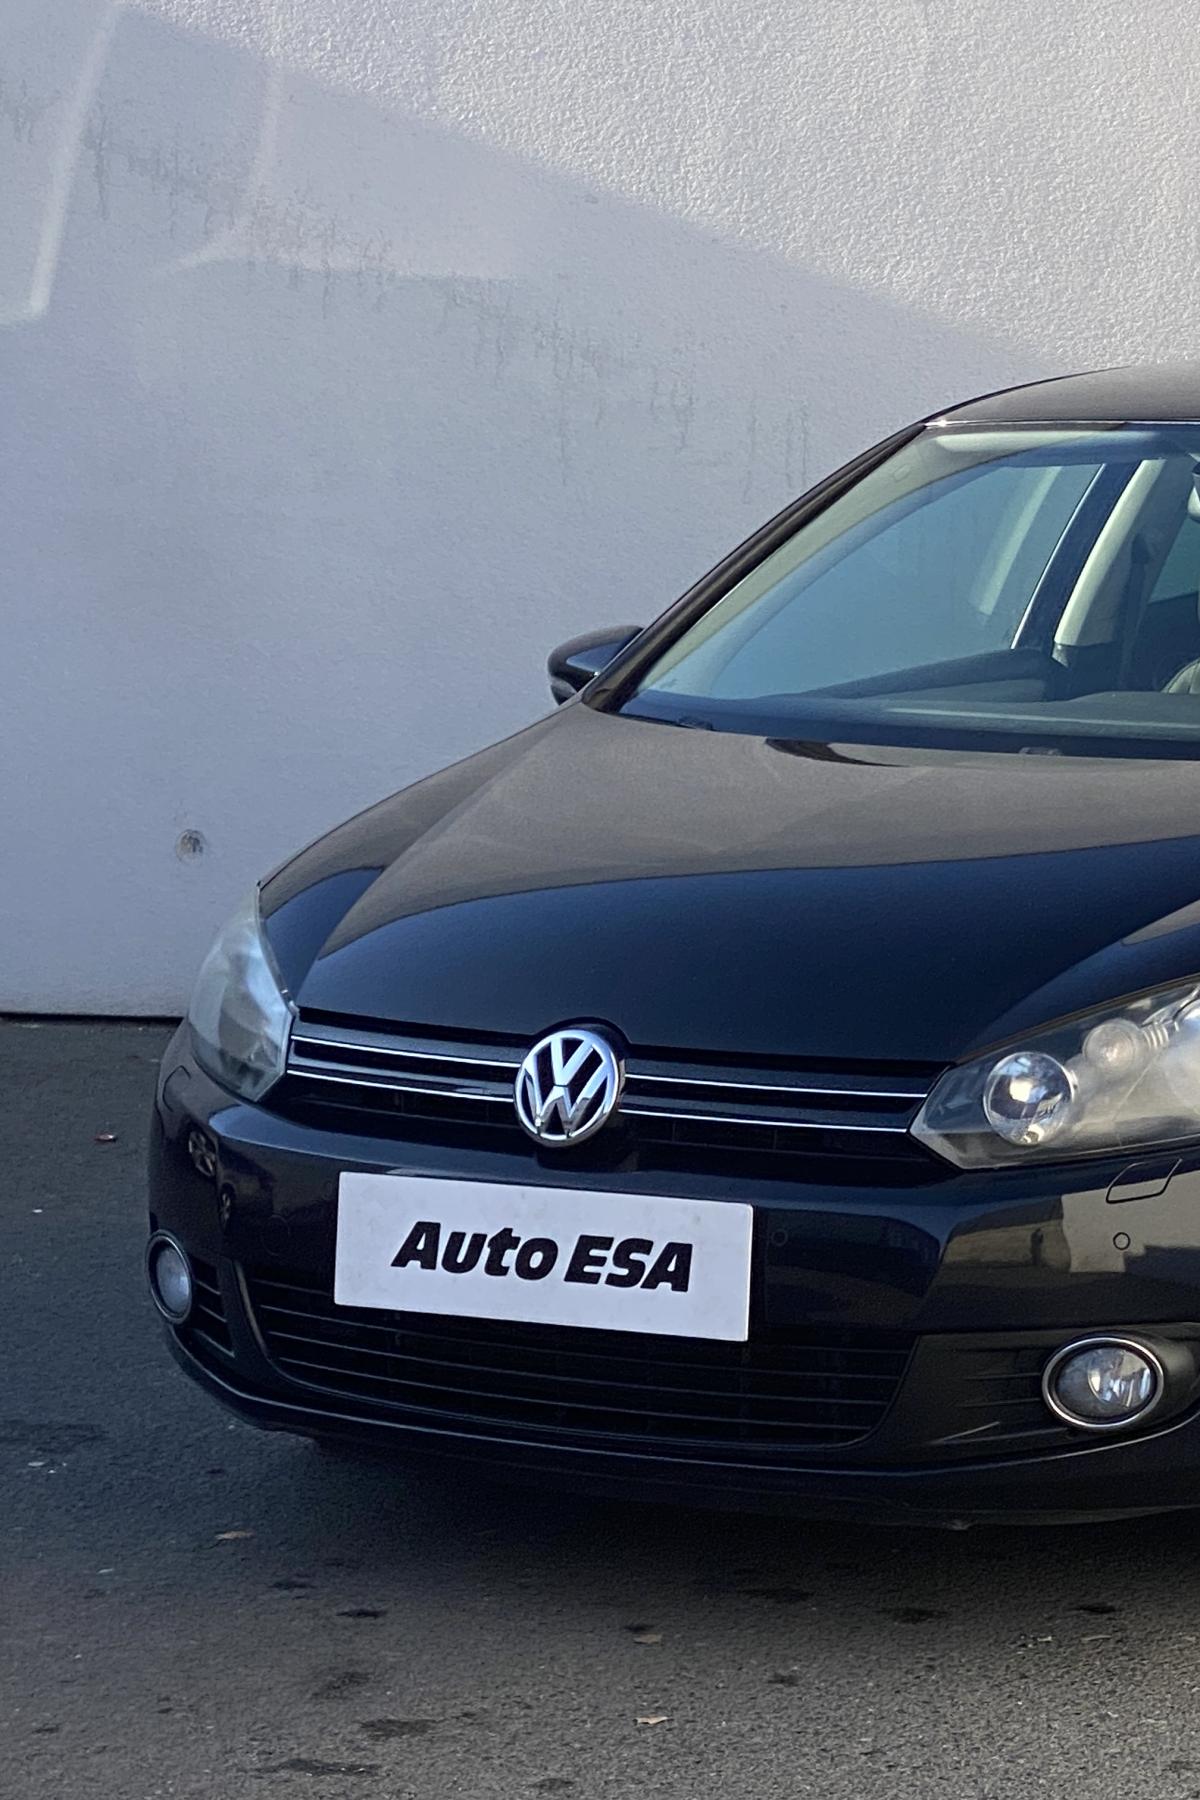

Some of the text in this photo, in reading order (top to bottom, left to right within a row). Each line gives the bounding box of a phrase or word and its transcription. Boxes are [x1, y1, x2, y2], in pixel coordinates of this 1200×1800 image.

[518, 1033, 617, 1141] VW
[391, 1221, 692, 1292] Auto ESA
